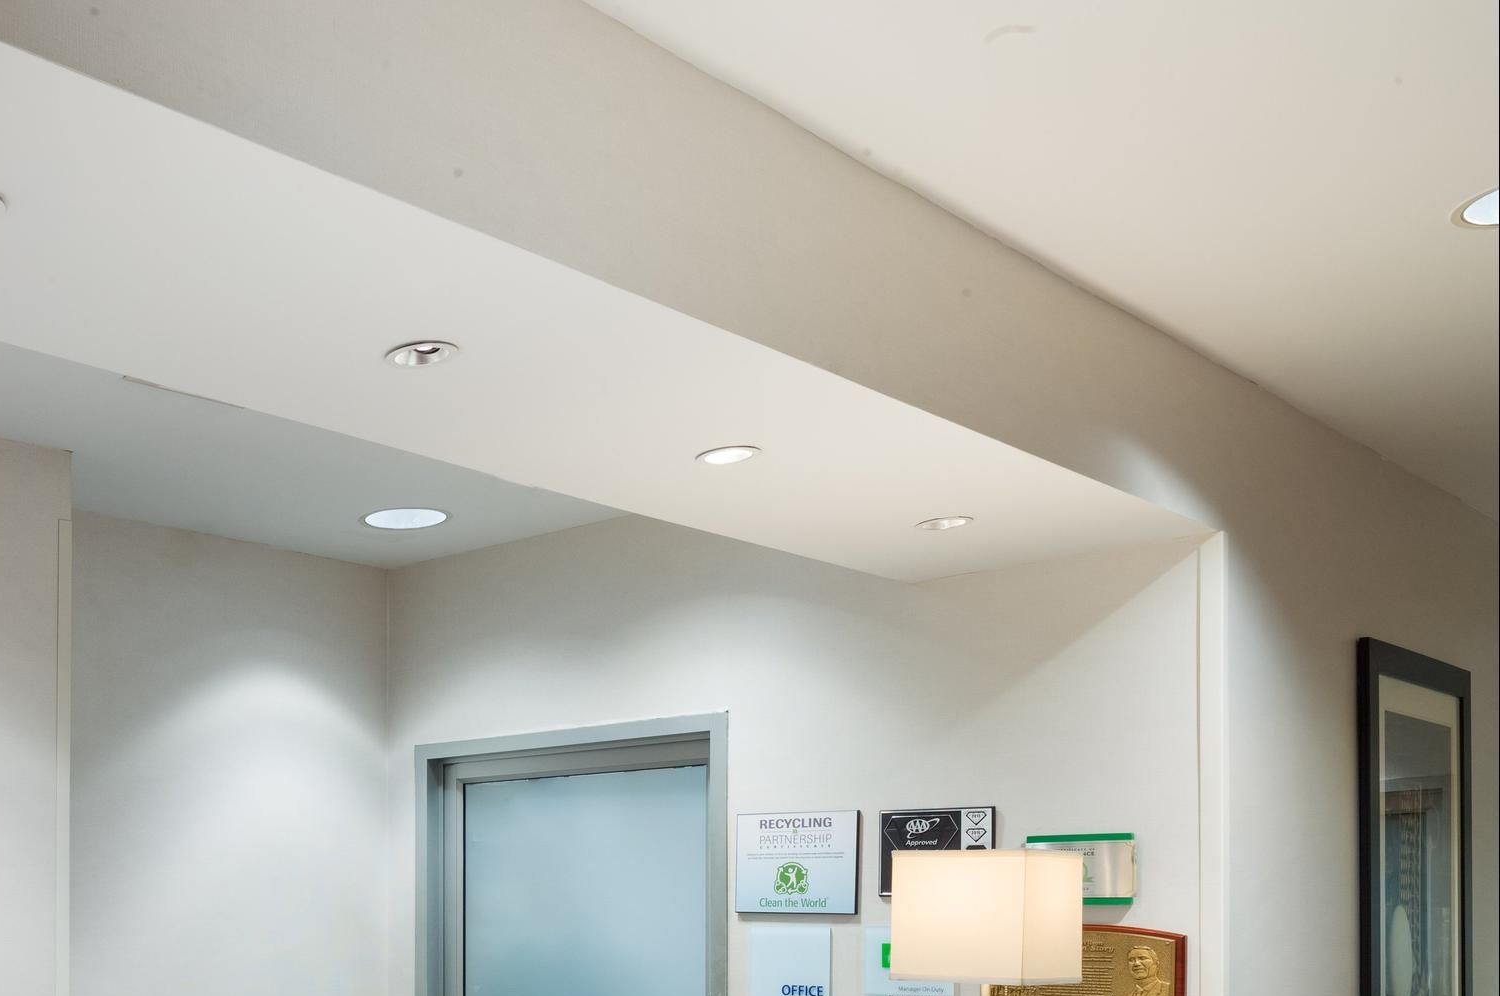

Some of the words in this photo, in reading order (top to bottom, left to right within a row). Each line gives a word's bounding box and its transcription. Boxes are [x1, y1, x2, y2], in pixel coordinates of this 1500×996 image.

[759, 817, 832, 830] RECYCLING
[908, 819, 929, 833] AAA
[759, 833, 832, 845] PARTNERSHIP
[905, 839, 938, 847] Approved
[759, 897, 783, 908] Clean
[785, 898, 798, 908] the
[800, 898, 827, 908] World
